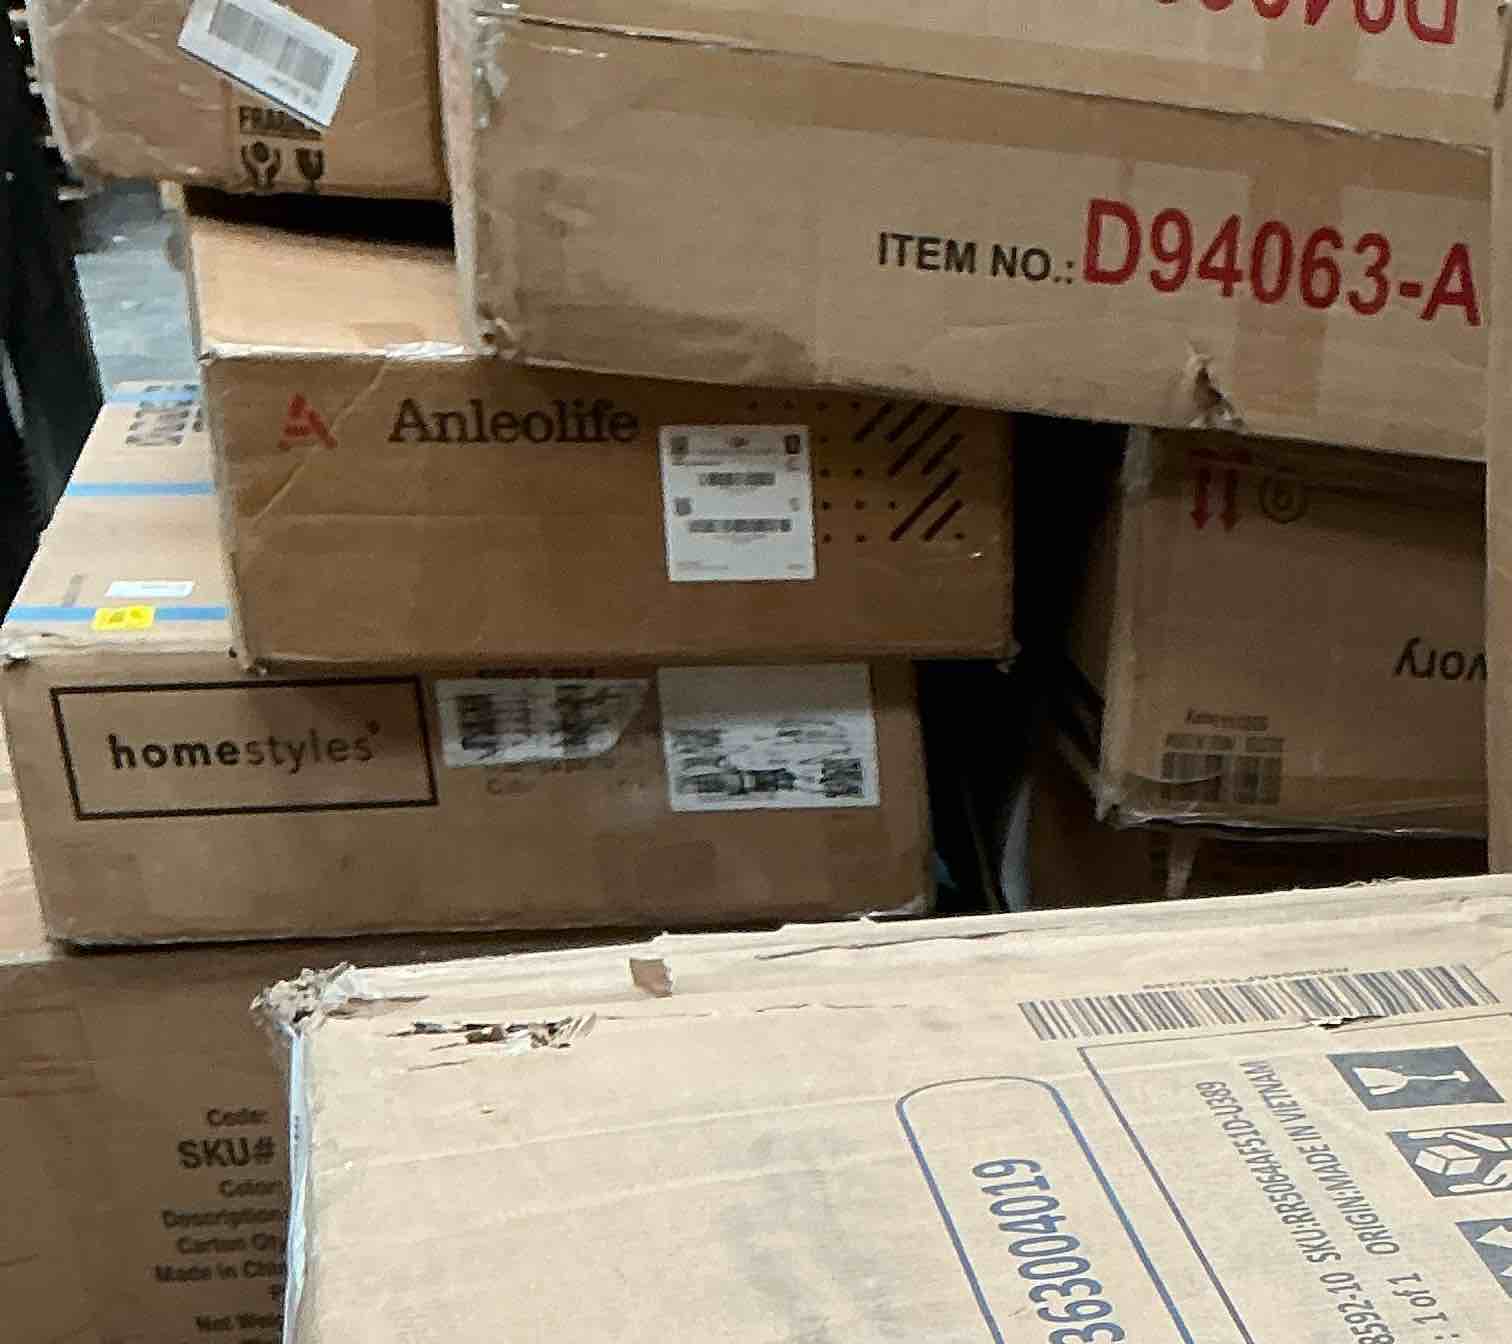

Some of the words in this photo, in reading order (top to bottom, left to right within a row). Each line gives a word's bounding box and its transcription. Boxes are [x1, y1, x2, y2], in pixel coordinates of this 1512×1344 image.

[877, 231, 977, 275] ITEM
[1083, 198, 1481, 328] D94063-A
[387, 398, 640, 444] Anleolife
[1240, 1059, 1307, 1123] VIETNAM
[1283, 1125, 1322, 1142] IN
[1195, 1080, 1342, 1264] SKU:RR5064AF51D-U389
[1297, 1143, 1400, 1256] ORIGIN:MADE
[1386, 1272, 1422, 1285] 1
[1391, 1289, 1437, 1308] of
[1412, 1312, 1448, 1325] 1
